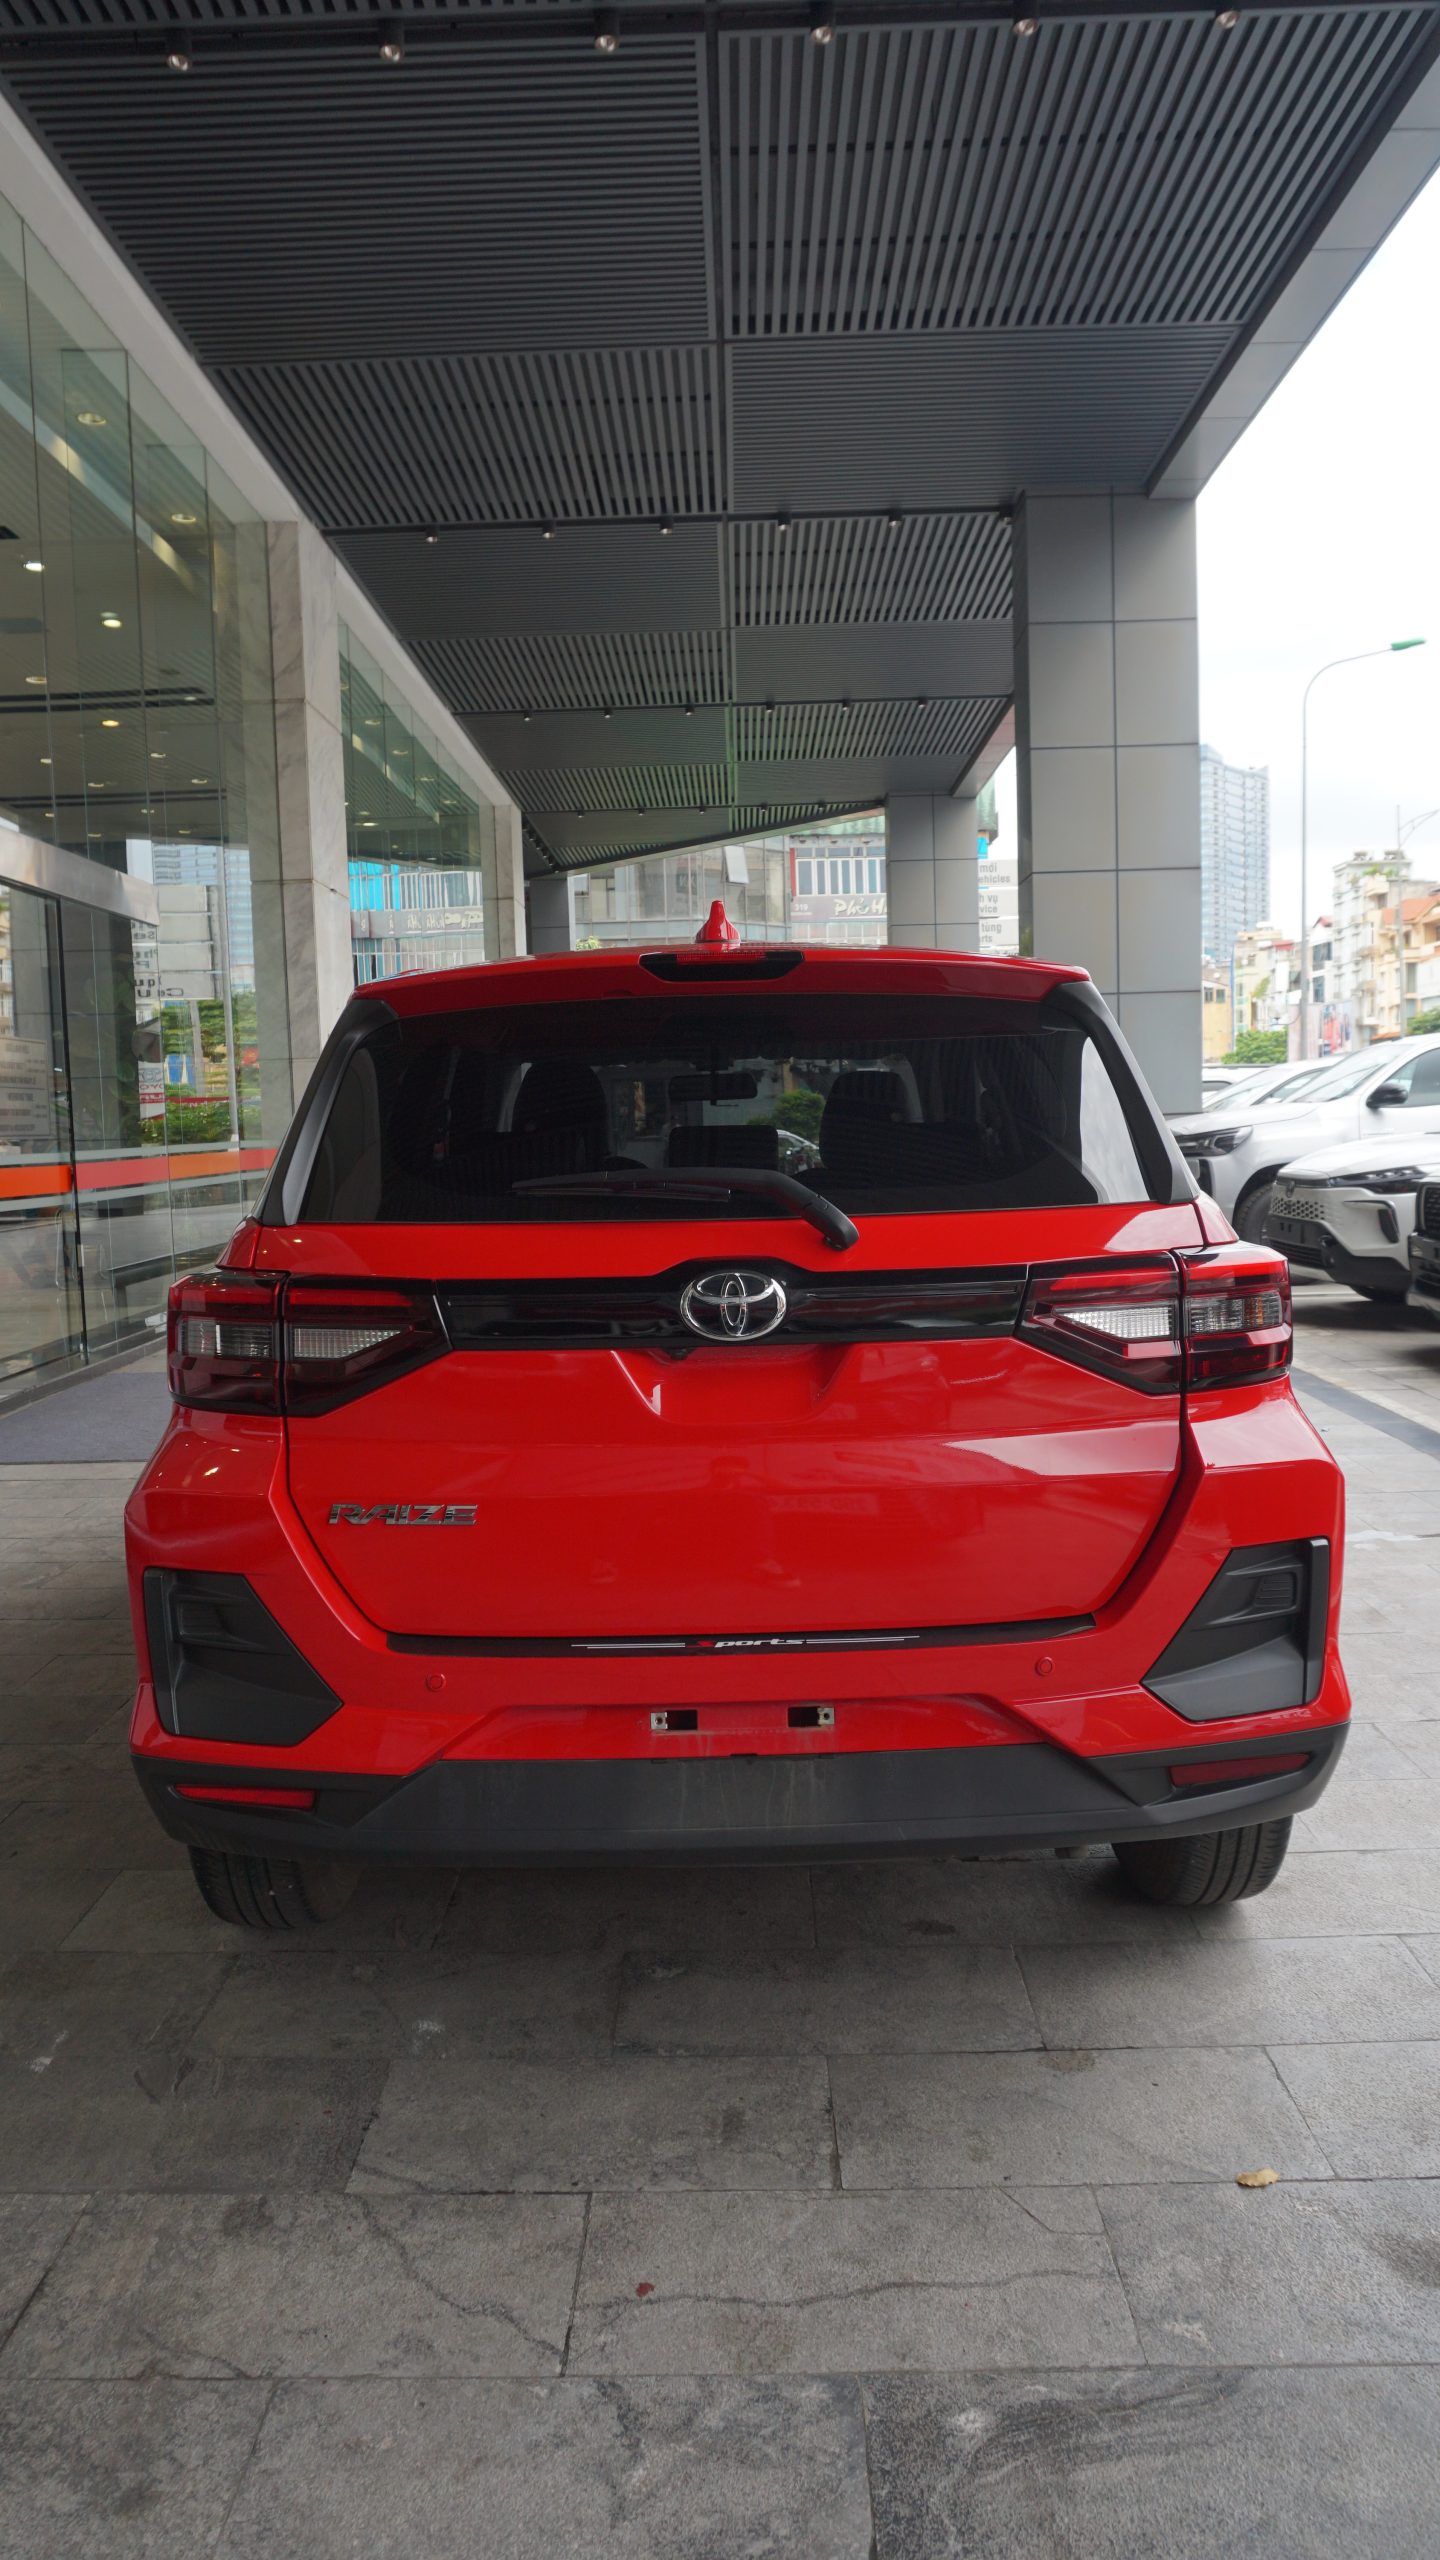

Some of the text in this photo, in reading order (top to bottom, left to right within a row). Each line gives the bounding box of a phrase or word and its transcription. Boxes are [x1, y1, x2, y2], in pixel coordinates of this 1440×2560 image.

[978, 875, 1011, 884] ehicles
[794, 903, 809, 912] 319
[328, 1503, 478, 1525] RAIZE
